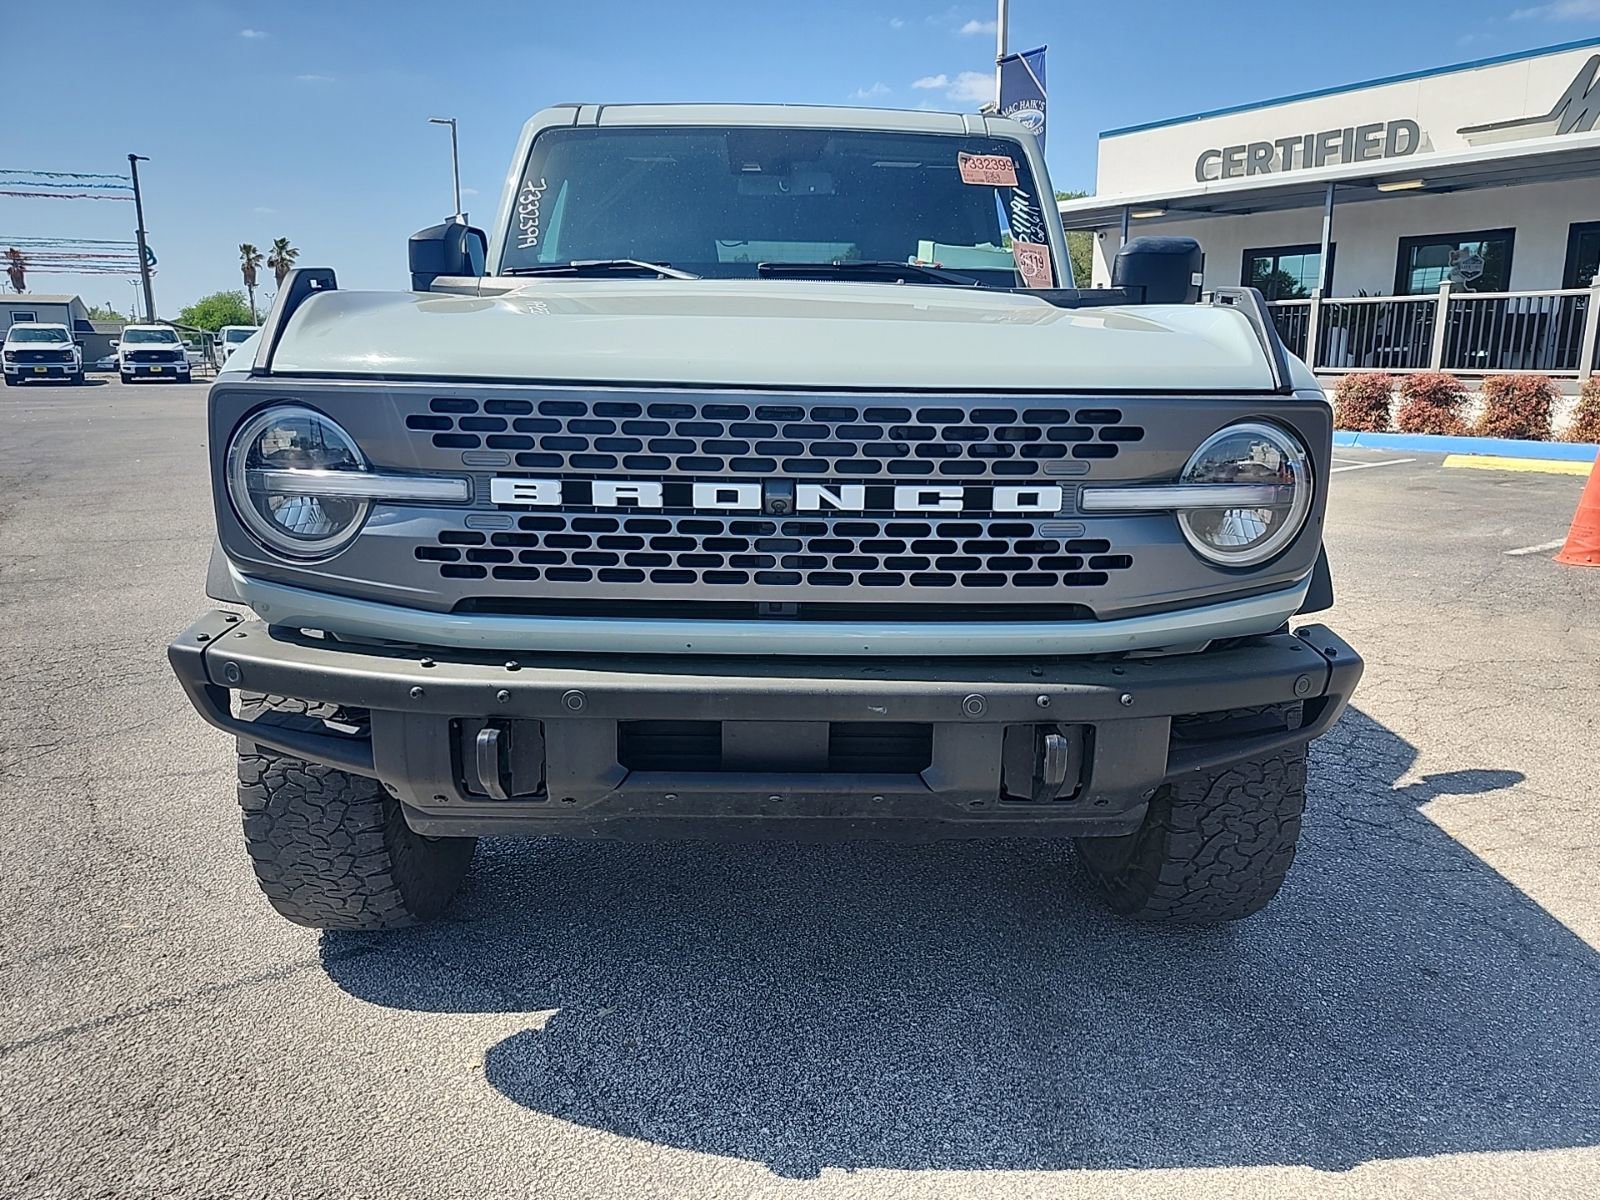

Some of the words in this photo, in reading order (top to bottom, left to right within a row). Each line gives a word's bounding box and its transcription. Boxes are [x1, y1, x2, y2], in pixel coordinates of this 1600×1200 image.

[1001, 102, 1018, 117] MAC
[1019, 99, 1045, 111] HAIK'S
[961, 157, 1013, 171] 7332399
[1196, 119, 1420, 182] CERTIFIED
[518, 178, 547, 249] 7332399
[490, 477, 1063, 512] BRONCO
